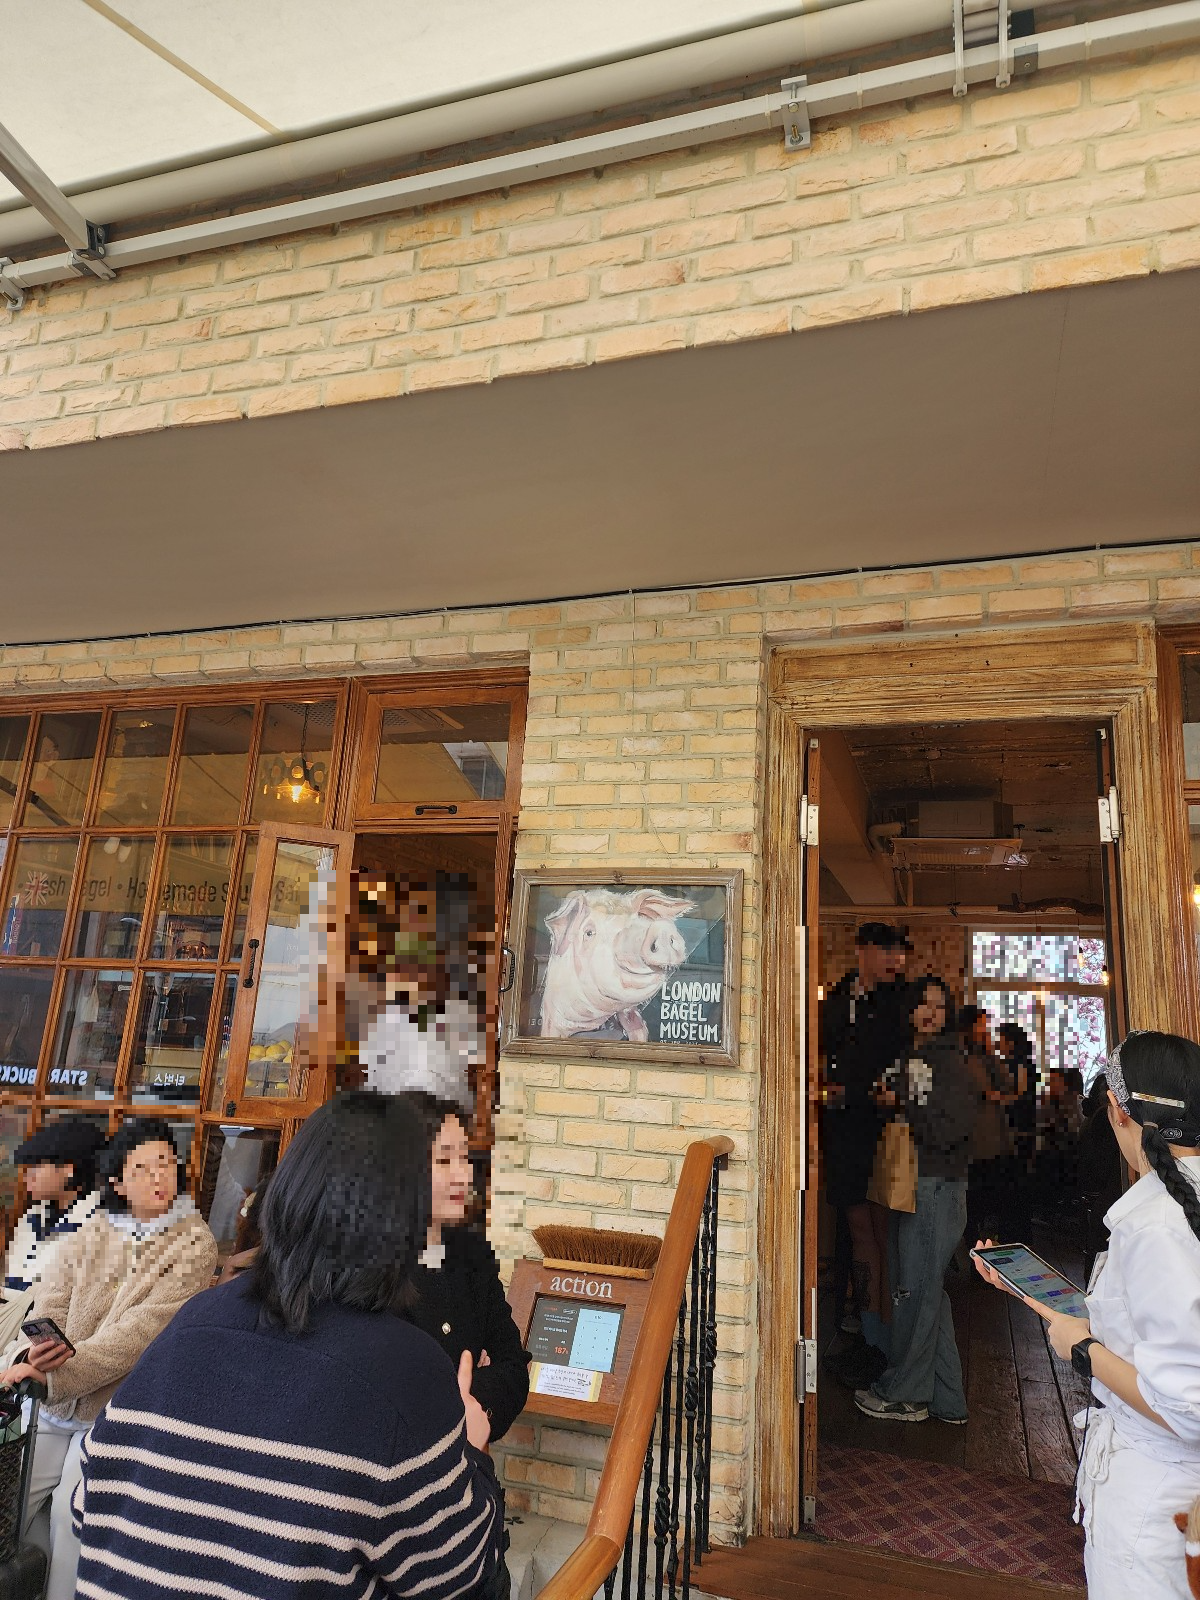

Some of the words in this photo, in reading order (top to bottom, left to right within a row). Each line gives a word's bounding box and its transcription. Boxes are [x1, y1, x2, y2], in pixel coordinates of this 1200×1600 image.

[127, 876, 217, 903] Hoemade
[661, 981, 721, 1003] LONDON
[660, 1002, 707, 1022] BAGEL
[550, 1273, 613, 1299] action
